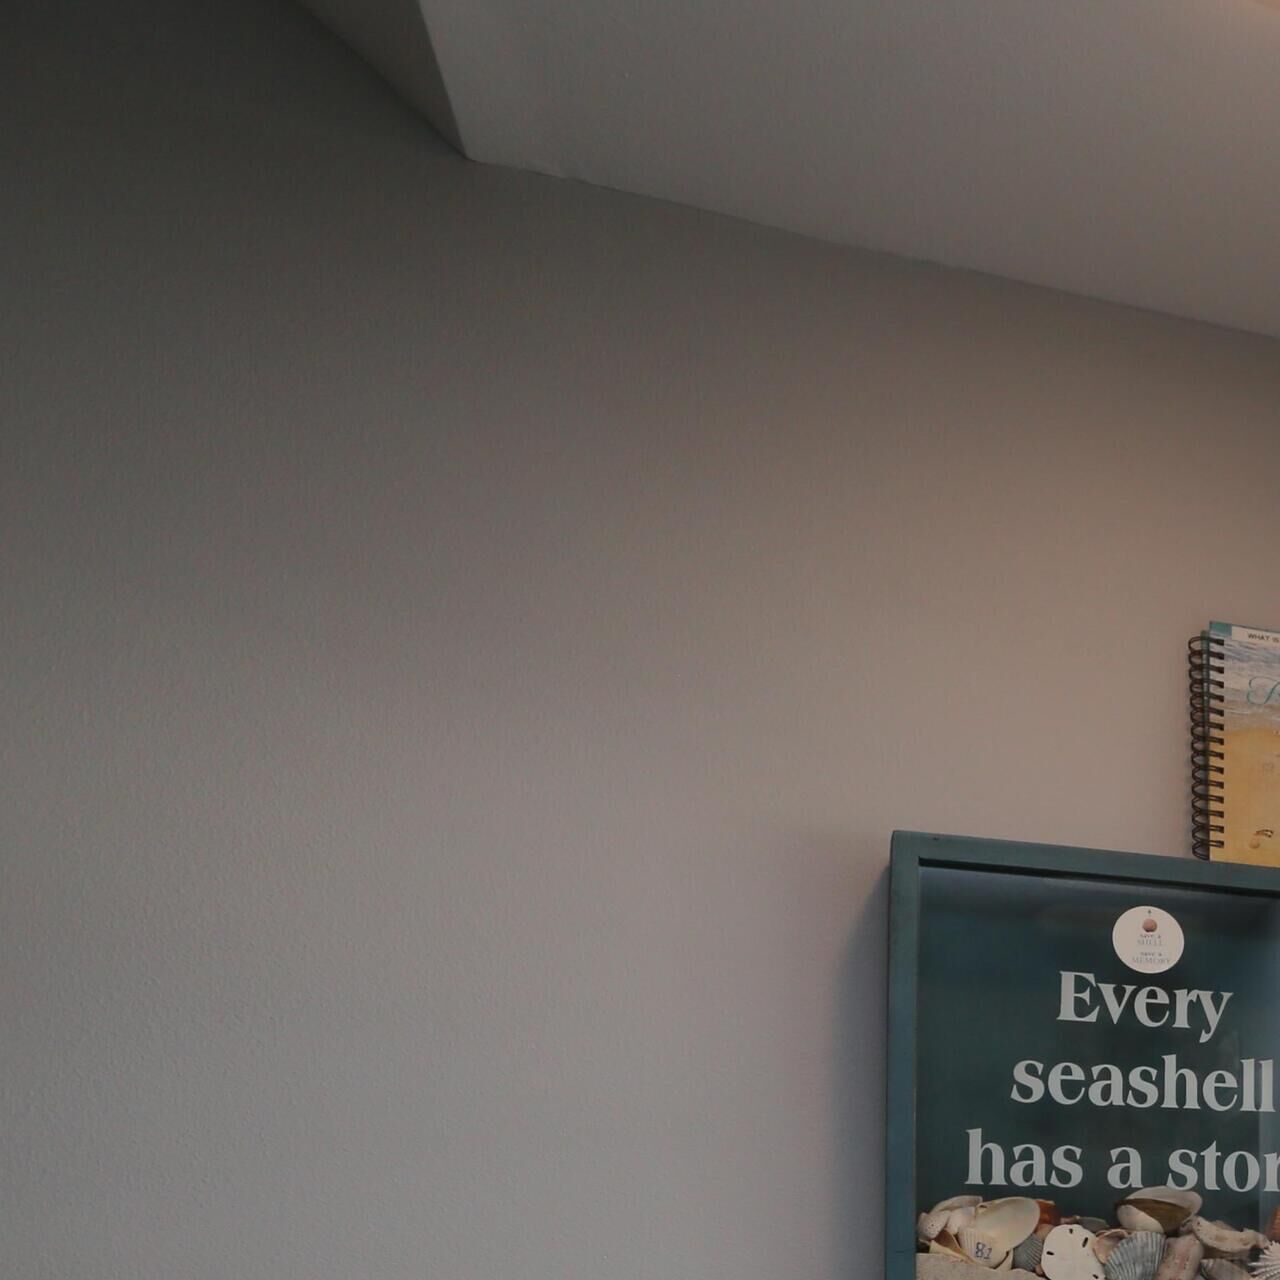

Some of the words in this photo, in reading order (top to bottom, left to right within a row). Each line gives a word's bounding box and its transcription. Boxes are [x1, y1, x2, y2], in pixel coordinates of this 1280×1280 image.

[1247, 632, 1269, 641] WHAT
[1272, 636, 1280, 644] IS
[1057, 970, 1233, 1043] Every
[1010, 1054, 1276, 1113] seashell
[965, 1127, 1083, 1188] has
[1107, 1146, 1144, 1189] a
